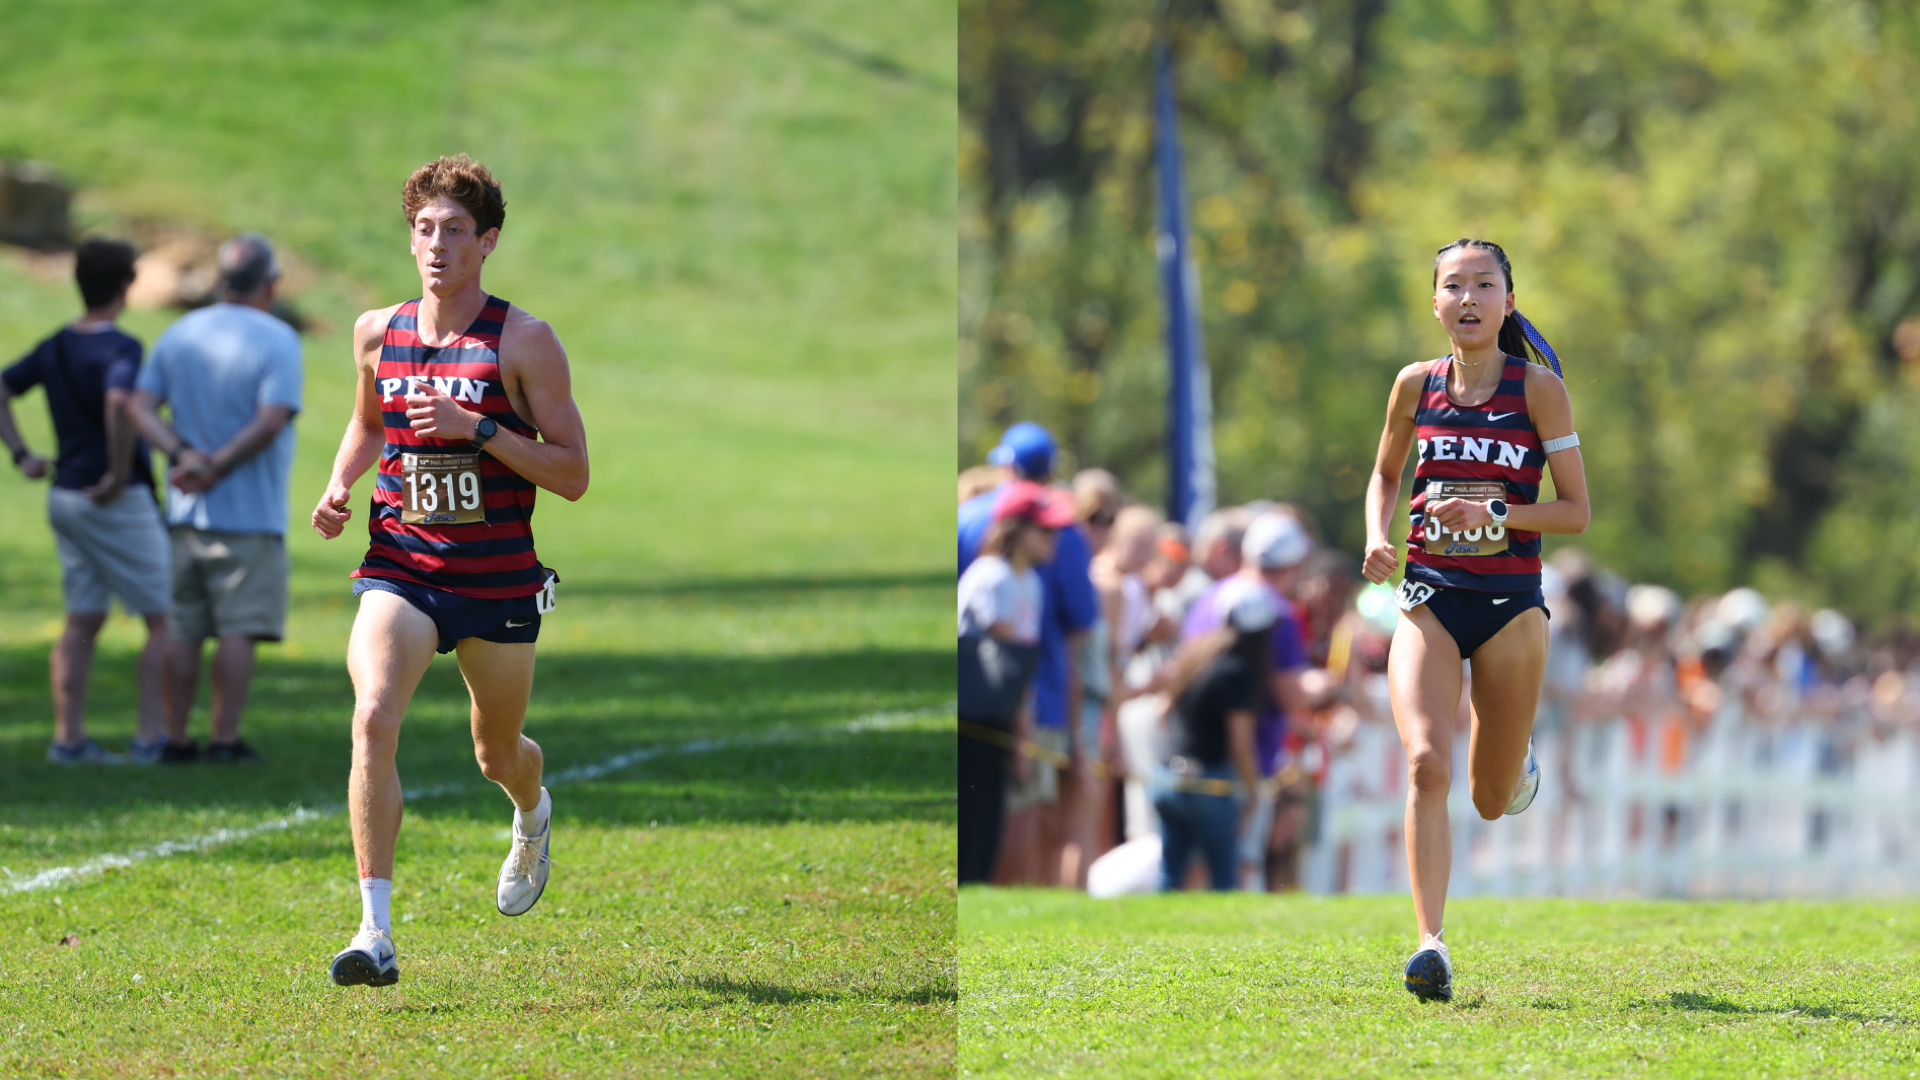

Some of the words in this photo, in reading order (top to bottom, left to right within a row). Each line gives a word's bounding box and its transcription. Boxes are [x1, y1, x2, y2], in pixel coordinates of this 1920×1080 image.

[381, 375, 489, 404] PENN
[1417, 436, 1529, 470] PENN
[405, 471, 480, 512] 1319
[1455, 544, 1480, 553] asics
